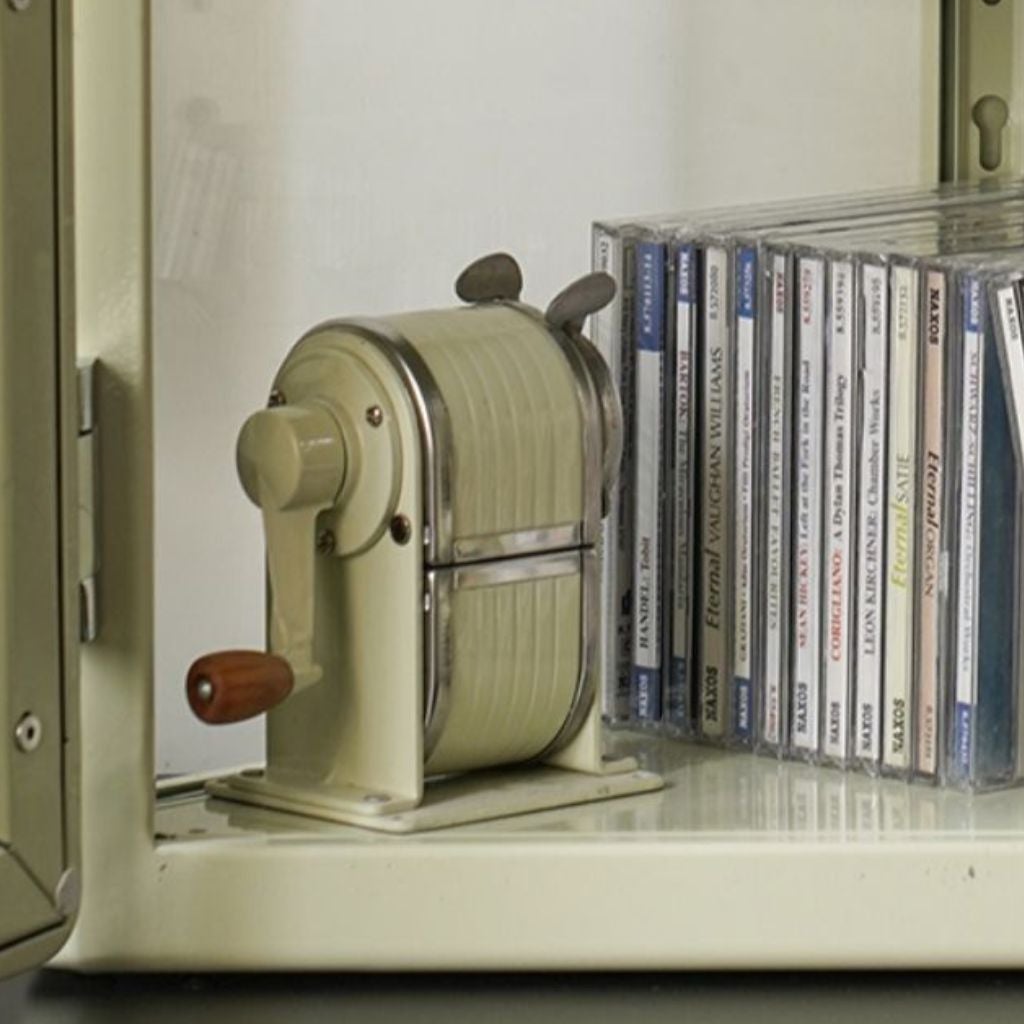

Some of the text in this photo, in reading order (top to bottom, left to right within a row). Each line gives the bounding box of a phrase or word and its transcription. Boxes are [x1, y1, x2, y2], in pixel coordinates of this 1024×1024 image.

[680, 252, 688, 295] NAXOS
[776, 272, 784, 313] NAXOS
[927, 288, 940, 345] NAXOS
[970, 279, 978, 324] NAXOS
[1005, 298, 1019, 339] NAXOS
[710, 348, 722, 438] WILLIAMS
[801, 360, 809, 394] Road
[834, 375, 847, 423] Trilogy
[801, 398, 809, 418] the
[802, 422, 809, 434] in
[869, 389, 880, 435] Works
[800, 439, 809, 469] Fork
[834, 426, 844, 479] Thomas
[867, 440, 880, 506] Chamber
[709, 446, 721, 544] VAUGHAN
[801, 496, 808, 509] at
[833, 484, 845, 525] Dylan
[800, 513, 808, 539] Left
[833, 531, 842, 539] A
[641, 537, 650, 570] Tobit
[800, 542, 808, 605] HICKEY:
[864, 511, 878, 605] KIRCHNER:
[704, 550, 720, 629] Eternal
[830, 550, 842, 662] CORIGLIANO:
[640, 578, 649, 648] HANDEL:
[799, 609, 807, 648] SEAN
[864, 609, 876, 655] LEON
[640, 675, 648, 717] NAXOS
[706, 666, 718, 721] NAXOS
[739, 686, 748, 728] NAXOS
[797, 682, 807, 733] NAXOS
[830, 702, 840, 744] NAXOS
[862, 703, 873, 751] NAXOS
[892, 698, 905, 754] NAXOS
